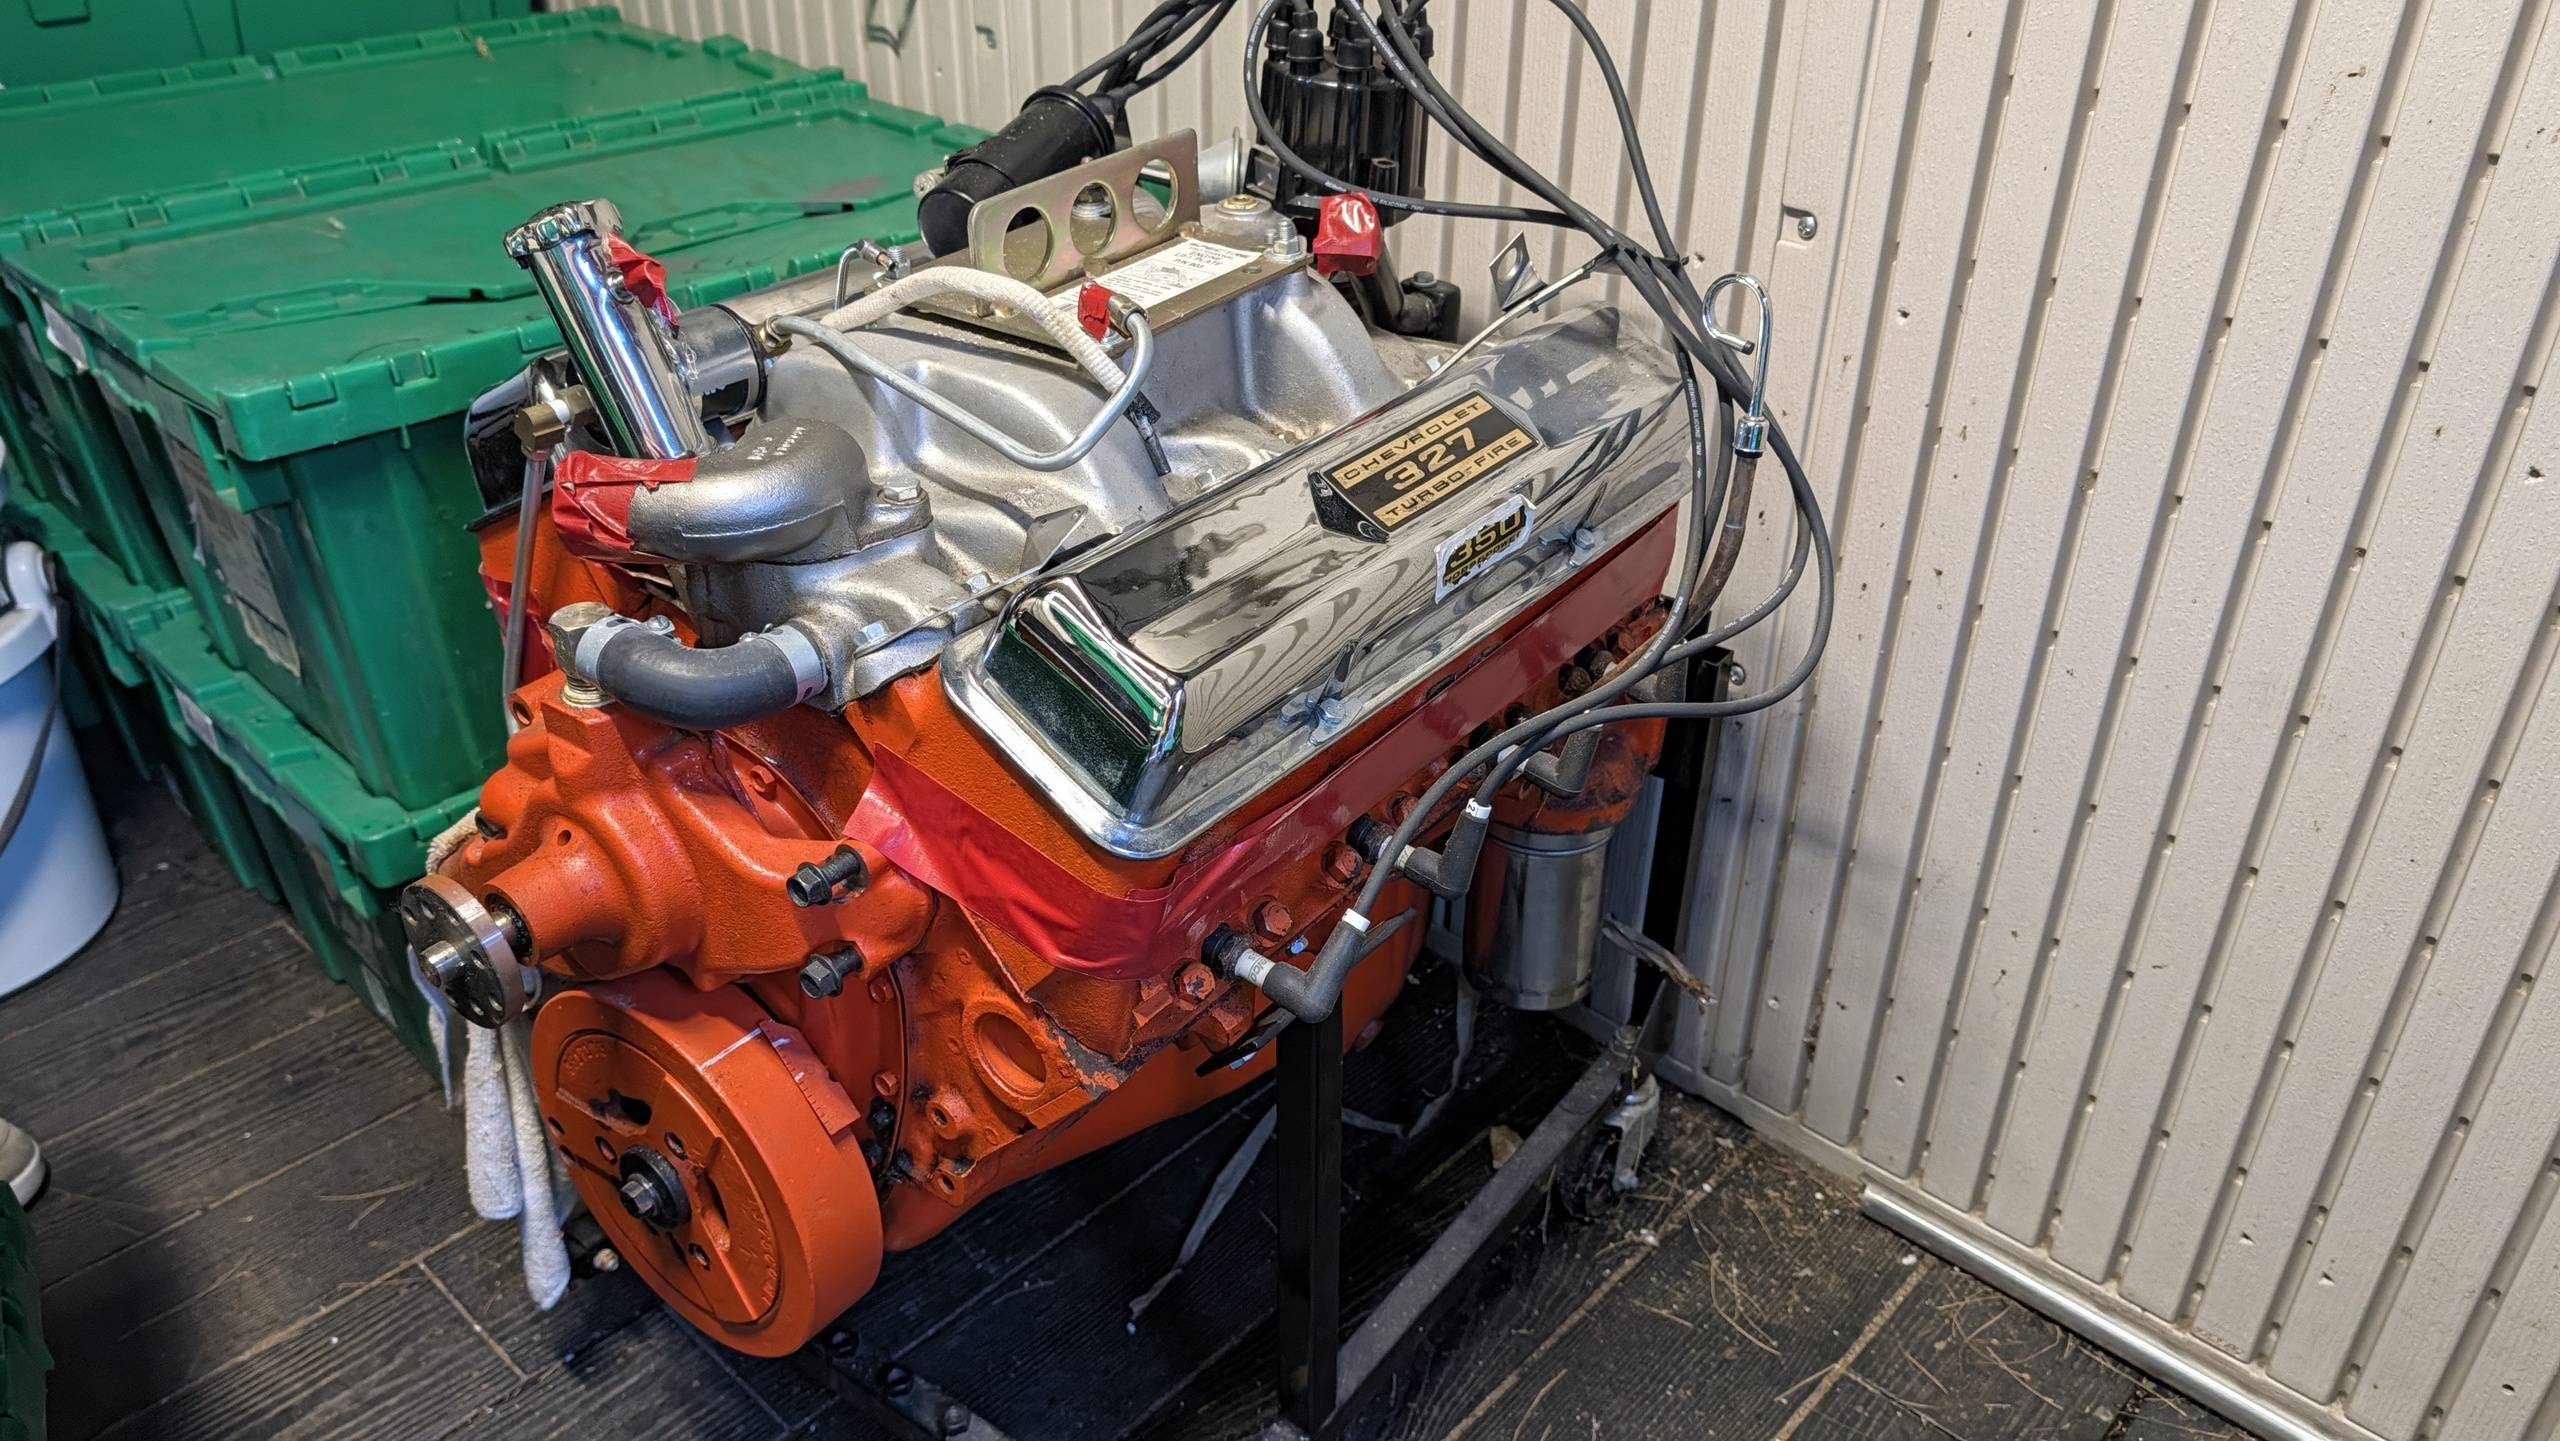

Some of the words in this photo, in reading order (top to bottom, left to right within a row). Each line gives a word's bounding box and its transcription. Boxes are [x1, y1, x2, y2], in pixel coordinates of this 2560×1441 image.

[1343, 402, 1480, 481] CHEVROLET
[1384, 427, 1476, 491] 327
[1385, 436, 1523, 518] TURBO-FIRE
[1450, 511, 1521, 569] 350
